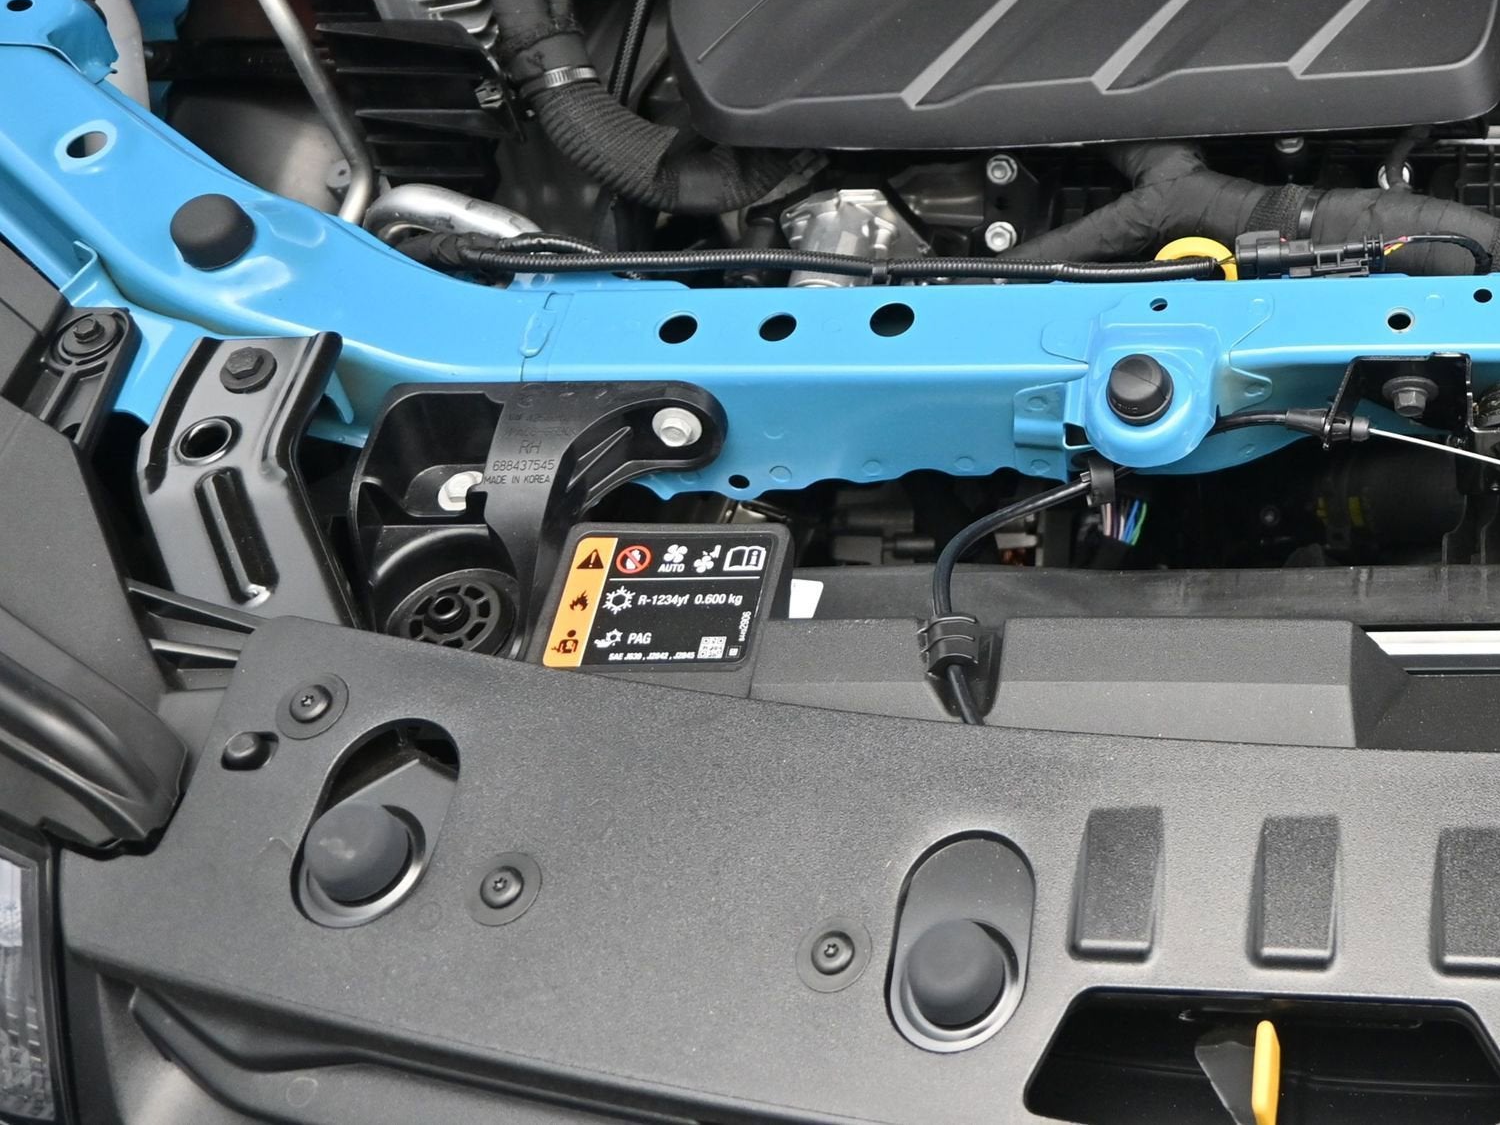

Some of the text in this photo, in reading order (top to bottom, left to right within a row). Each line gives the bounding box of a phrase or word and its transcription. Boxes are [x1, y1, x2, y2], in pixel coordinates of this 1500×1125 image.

[518, 439, 542, 454] RH
[482, 474, 551, 485] MADE IN KOREA
[657, 563, 685, 573] AUTO
[637, 593, 744, 607] R-1234yf 0.600 kg
[627, 632, 652, 645] PAG
[608, 652, 624, 661] SAE
